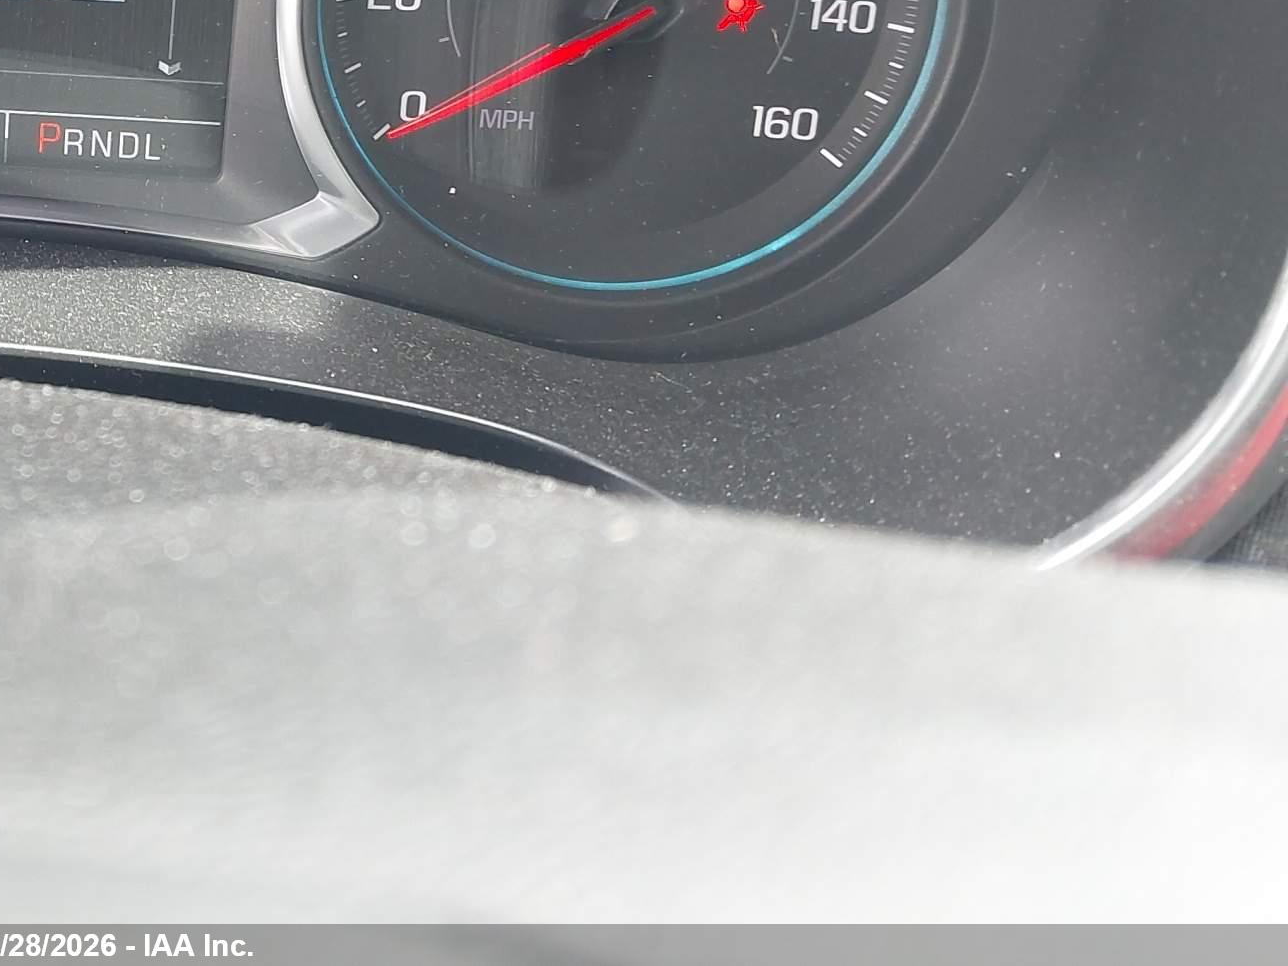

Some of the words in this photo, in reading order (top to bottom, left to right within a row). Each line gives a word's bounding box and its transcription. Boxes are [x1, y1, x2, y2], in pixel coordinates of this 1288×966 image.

[399, 91, 427, 121] 0
[479, 109, 535, 131] MPH
[752, 105, 819, 141] 160
